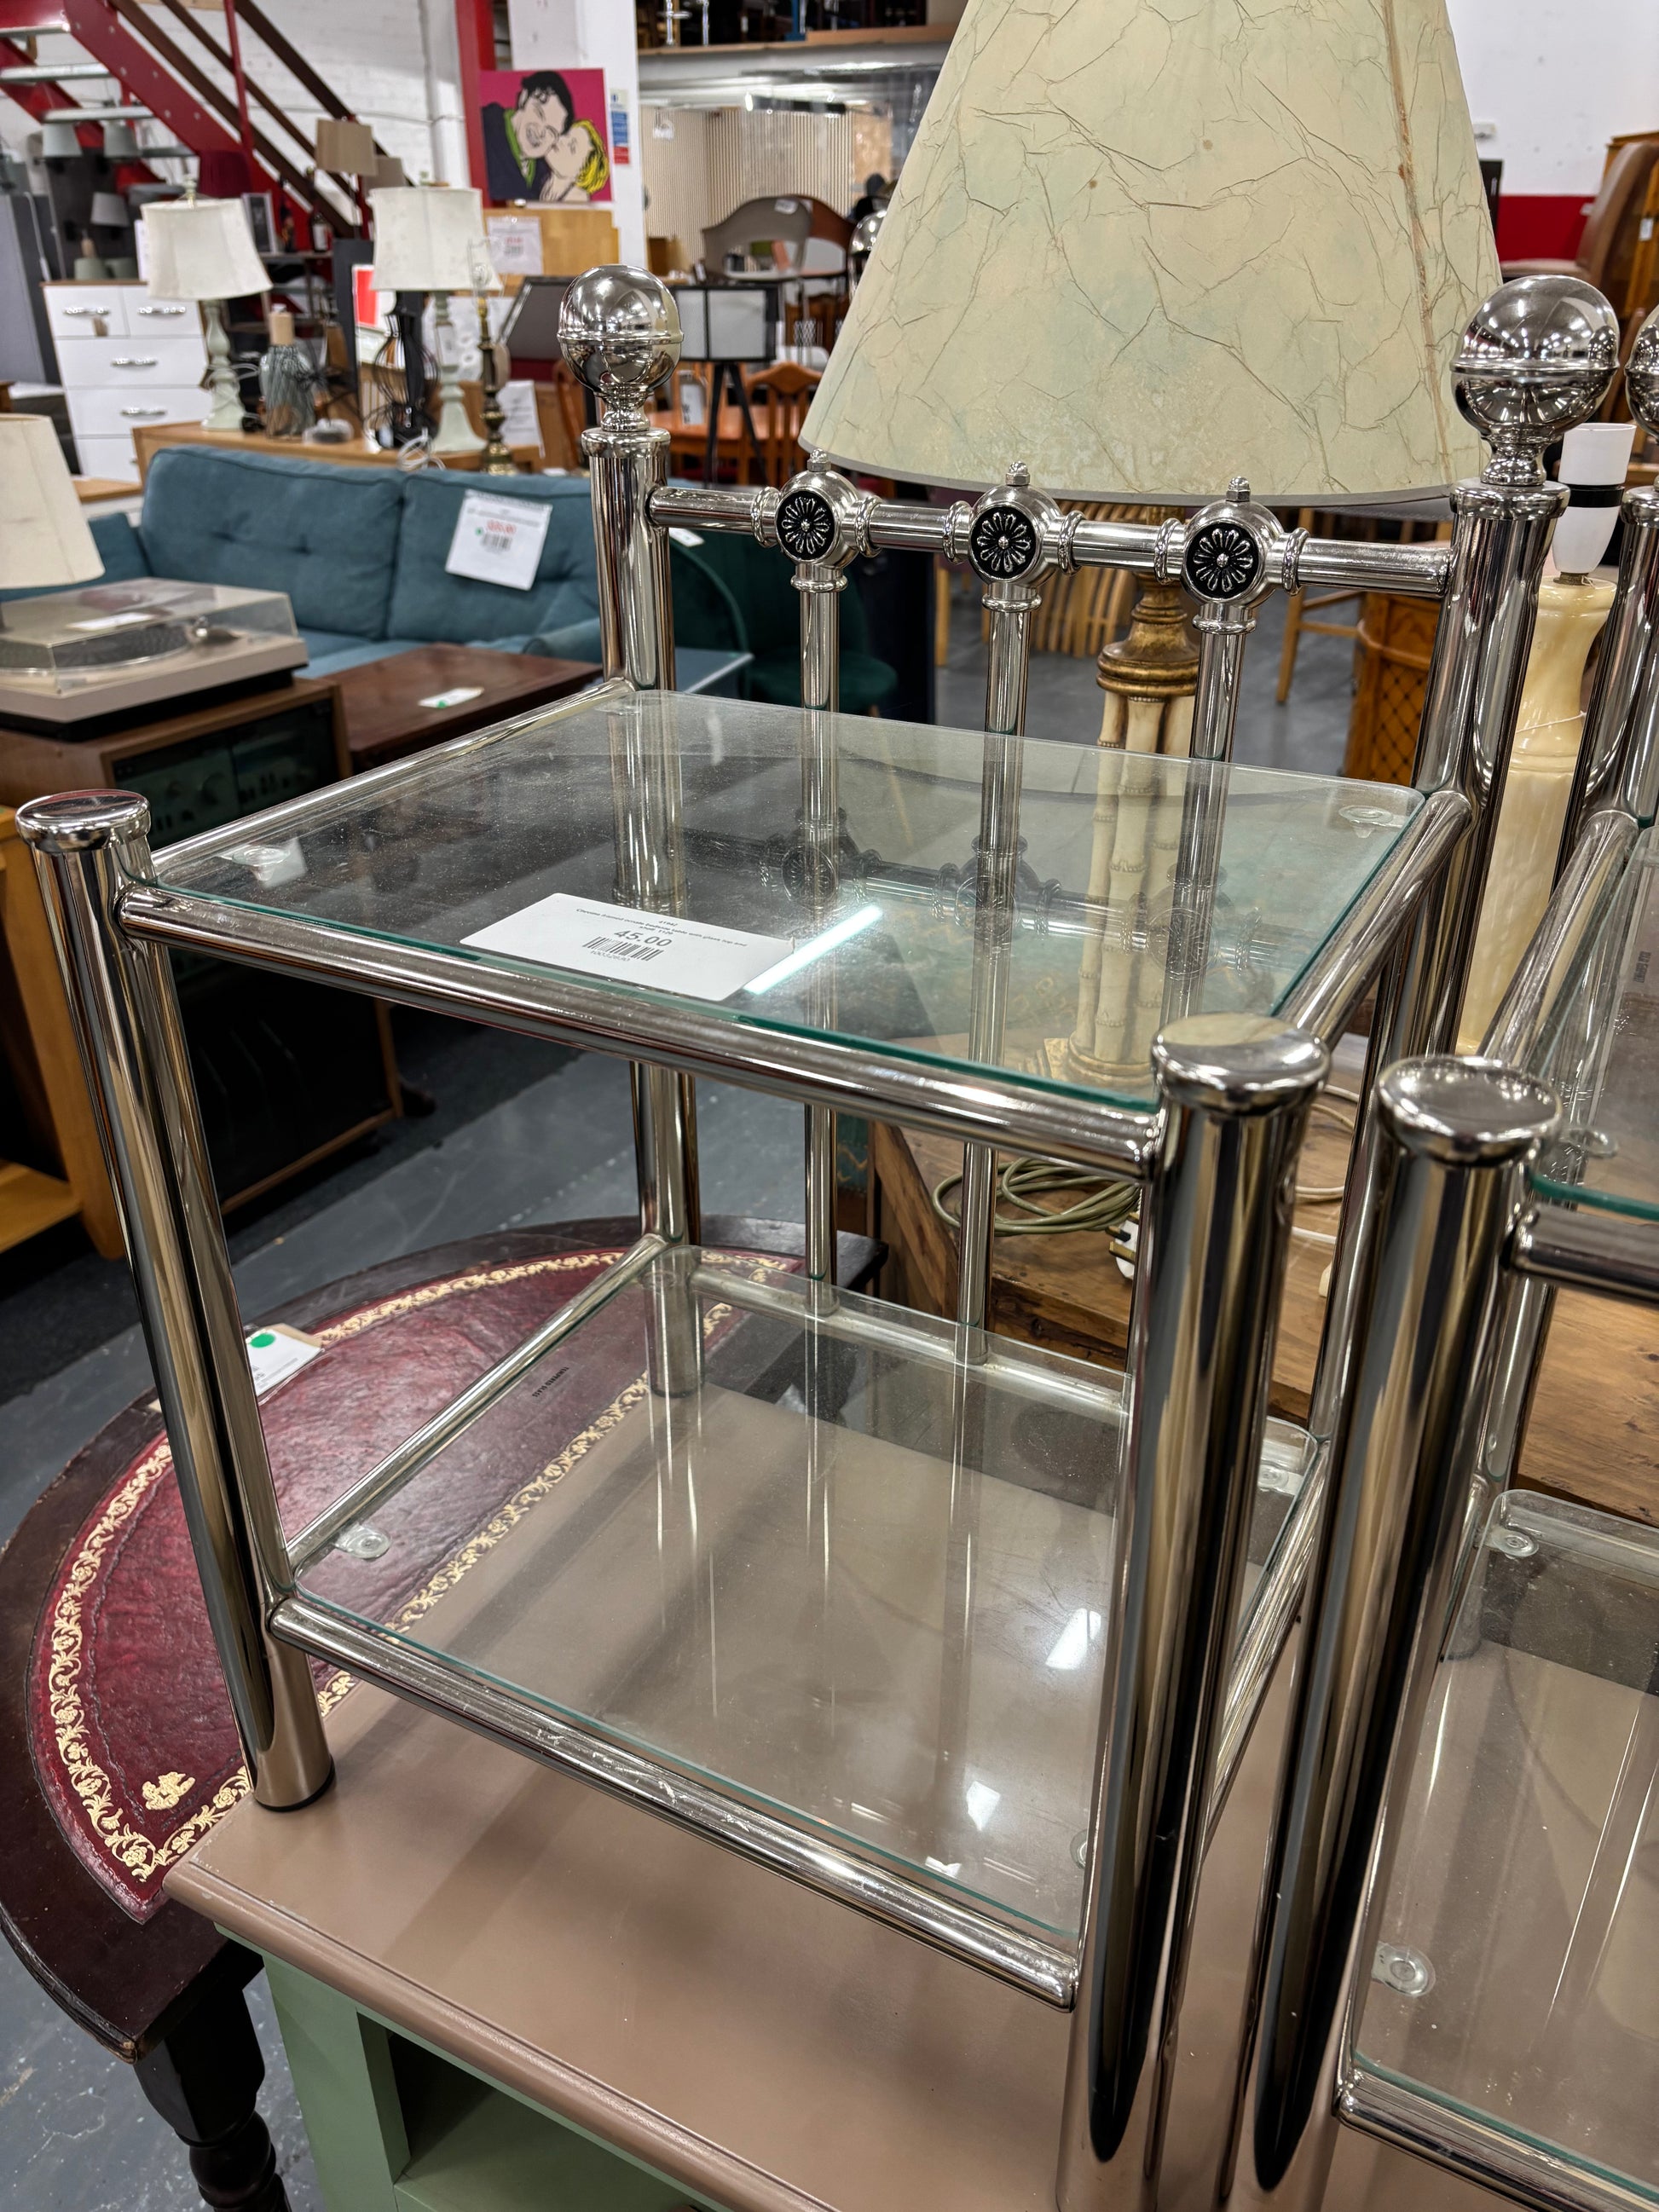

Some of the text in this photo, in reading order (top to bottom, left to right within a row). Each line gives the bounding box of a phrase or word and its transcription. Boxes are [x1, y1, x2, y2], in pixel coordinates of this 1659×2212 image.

[614, 930, 673, 947] 45.00
[531, 1366, 569, 1397] TEMPERED GLASS
